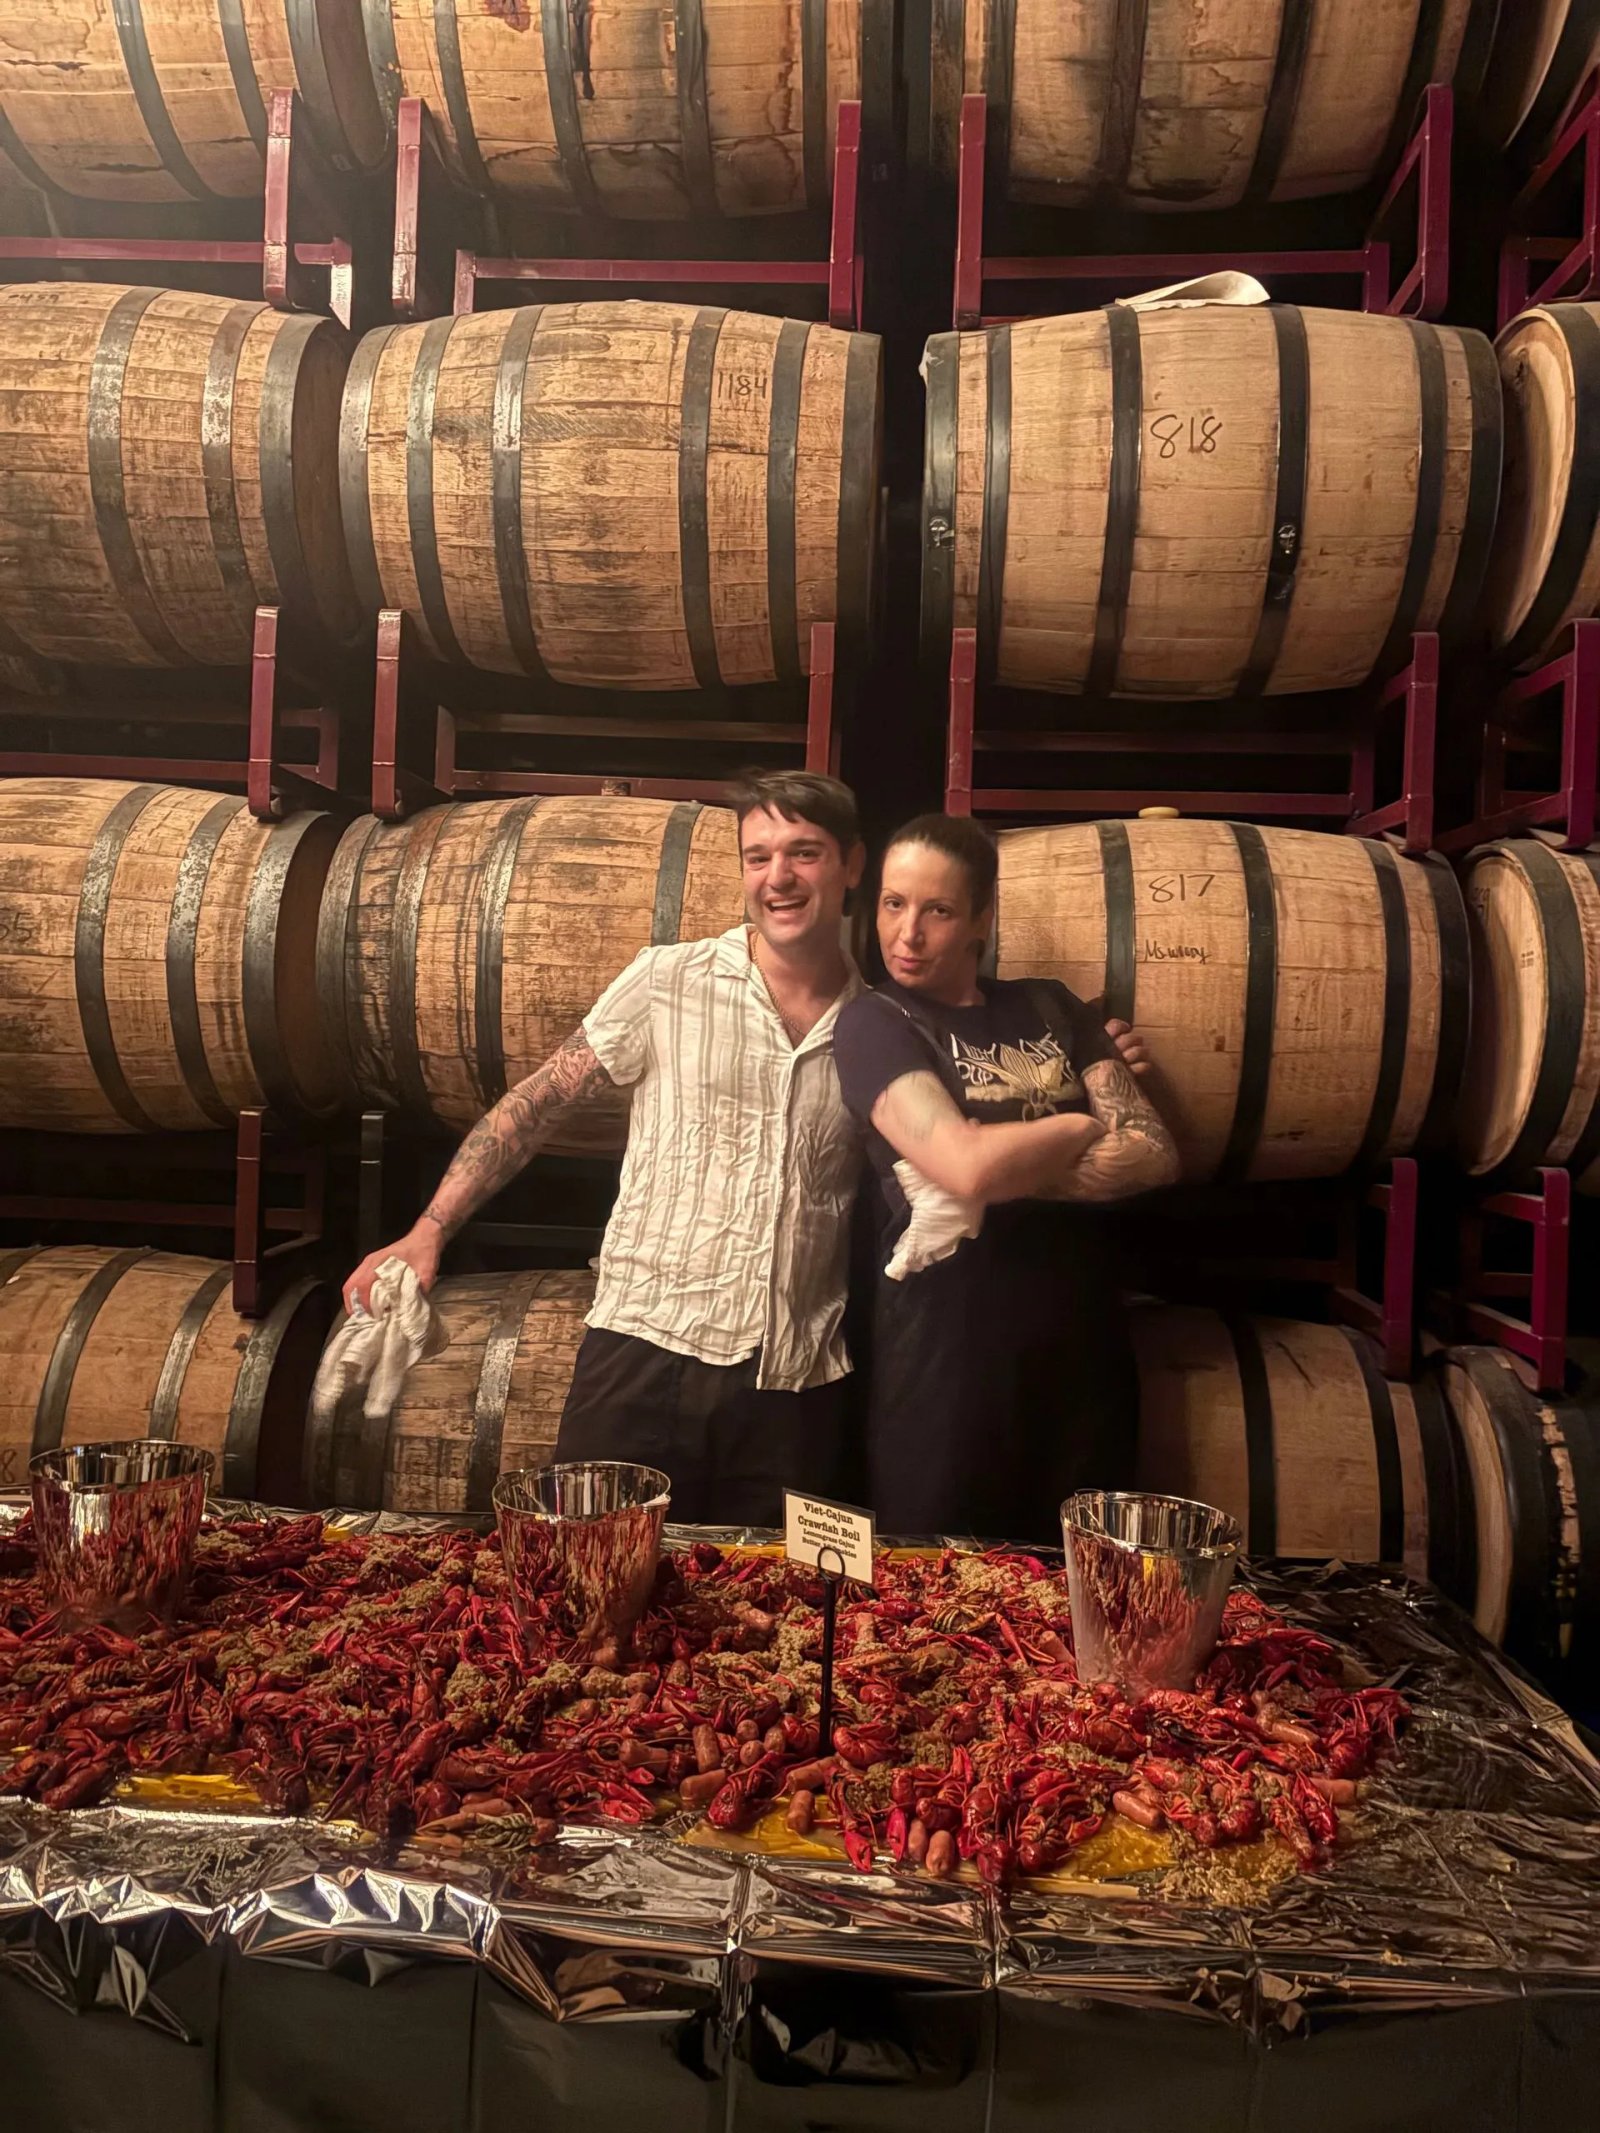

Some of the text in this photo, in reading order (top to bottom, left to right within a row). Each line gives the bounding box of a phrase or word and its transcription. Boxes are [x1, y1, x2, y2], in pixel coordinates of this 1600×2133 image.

[717, 371, 767, 400] 1184
[1150, 413, 1223, 458] 818
[1148, 873, 1216, 903] 817
[803, 1502, 854, 1525] Viet-Cajun
[797, 1515, 861, 1542] Crawfish Boil
